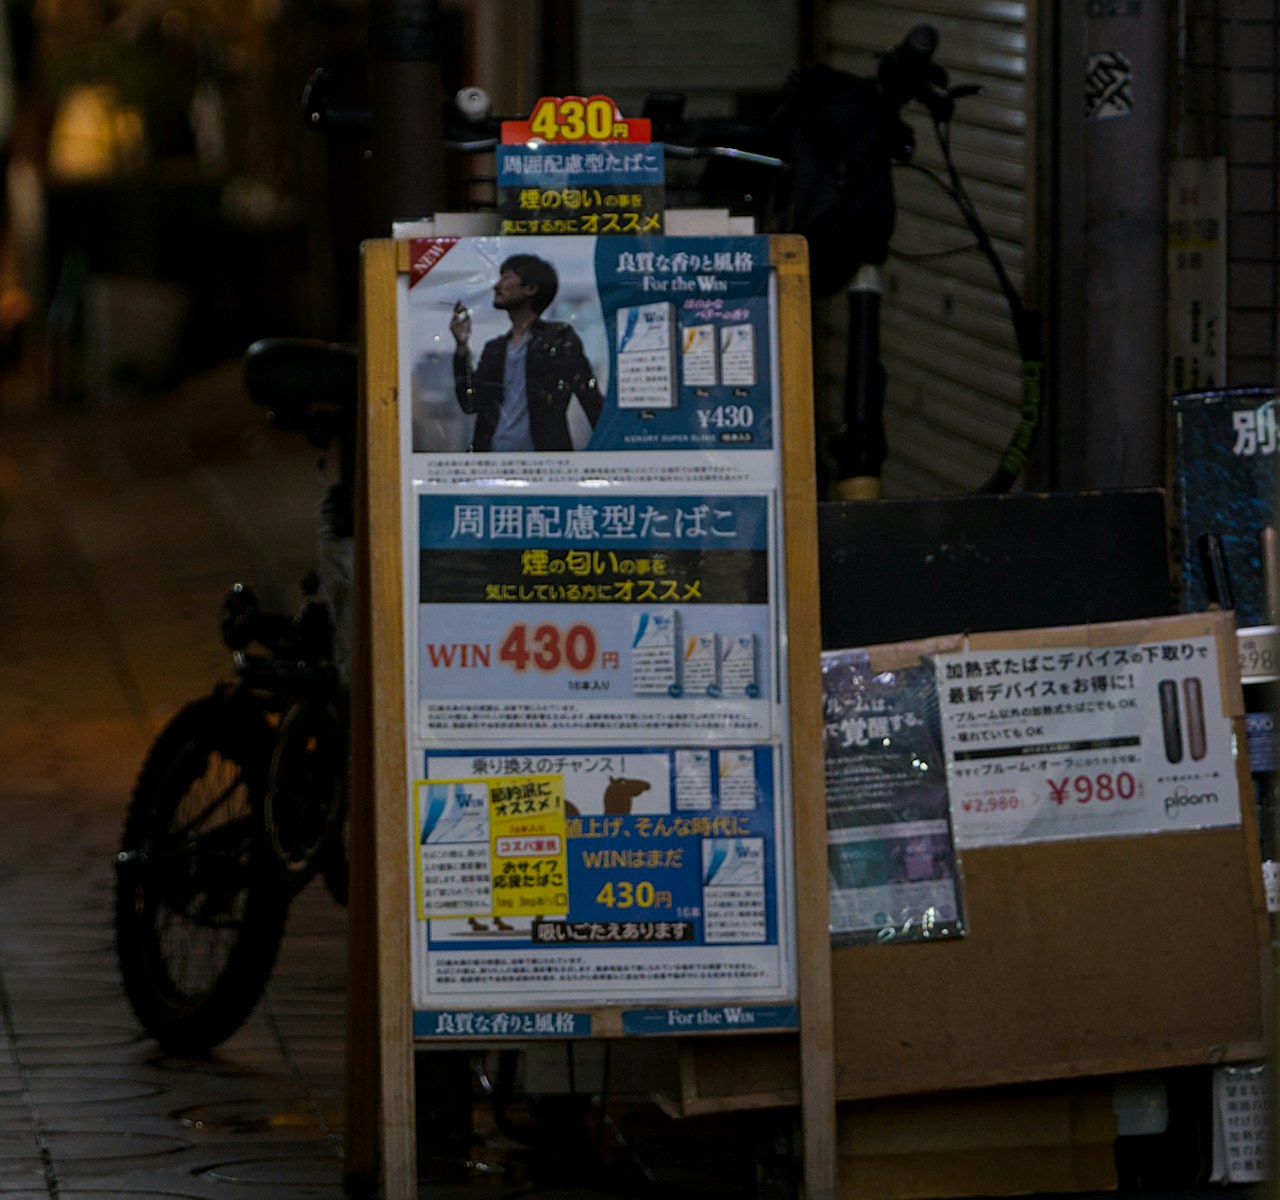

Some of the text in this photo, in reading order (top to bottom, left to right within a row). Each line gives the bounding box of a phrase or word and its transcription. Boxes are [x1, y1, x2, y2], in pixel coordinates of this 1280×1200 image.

[531, 99, 629, 140] 430円
[502, 153, 659, 175] 周囲配慮型たばこ
[520, 189, 642, 209] 煙の匂いの事を
[413, 242, 446, 275] NEW
[615, 251, 754, 273] 良質な香りと風格
[642, 275, 669, 292] For
[671, 275, 695, 291] the
[696, 404, 754, 429] ¥430
[1233, 410, 1280, 457] 別
[450, 503, 738, 540] 周囲配慮型たばこ
[521, 548, 667, 576] 煙の匂いの事を
[485, 579, 703, 601] 気にしている方にオススメ
[427, 624, 620, 671] WIN 430円
[946, 644, 1208, 679] 加熱式たばこデバイスの下取りで
[948, 674, 1136, 704] 最新デバイスをお得に!
[1046, 772, 1136, 805] ¥980
[1164, 785, 1219, 819] ploom
[582, 847, 685, 869] WINはまだ
[595, 881, 673, 910] 430円
[537, 922, 689, 941] 吸いごたえあります
[434, 1011, 576, 1034] 良質な香りと風格
[667, 1008, 694, 1027] For
[696, 1008, 721, 1026] the
